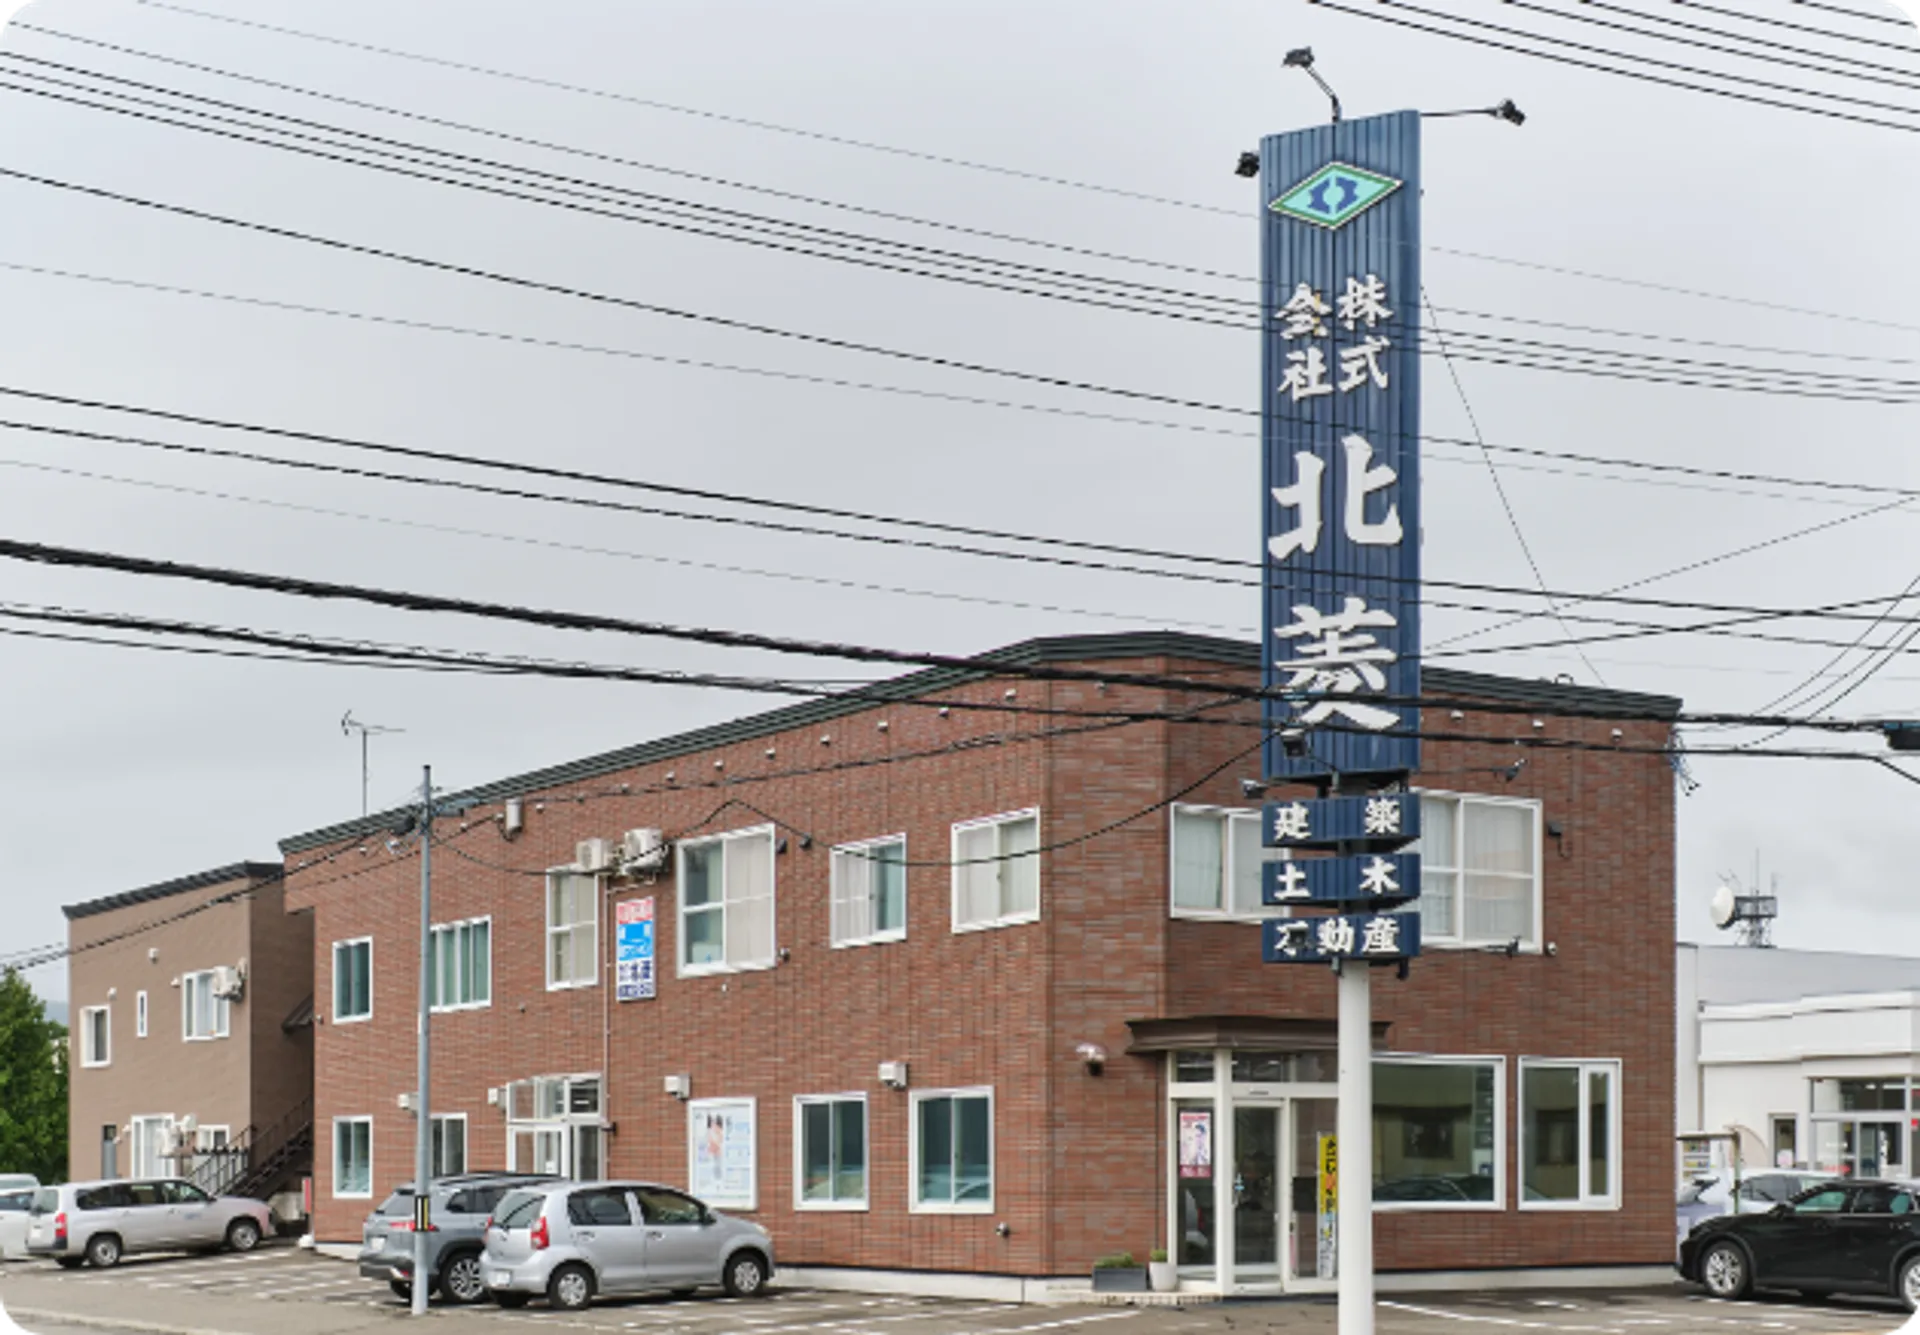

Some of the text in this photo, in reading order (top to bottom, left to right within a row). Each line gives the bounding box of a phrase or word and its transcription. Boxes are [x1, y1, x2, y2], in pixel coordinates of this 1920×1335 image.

[1274, 283, 1334, 402] 会社
[1337, 273, 1394, 392] 株式
[1268, 433, 1404, 737] 北菱
[1274, 797, 1400, 841] 建築
[1274, 856, 1400, 900] 土木
